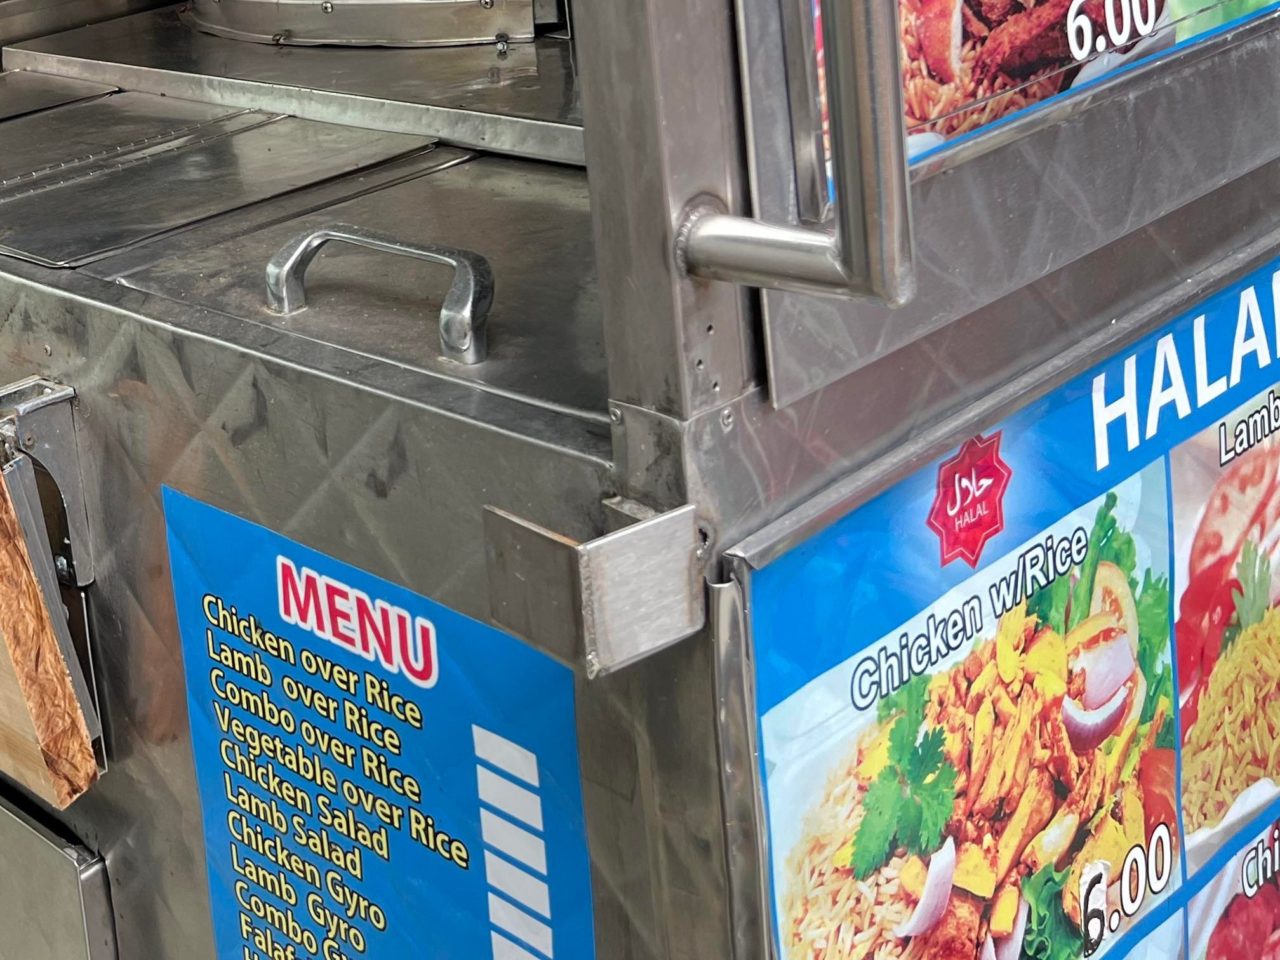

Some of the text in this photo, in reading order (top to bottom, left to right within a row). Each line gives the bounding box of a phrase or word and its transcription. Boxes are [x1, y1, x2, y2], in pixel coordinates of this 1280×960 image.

[1091, 269, 1280, 472] HALA
[1219, 389, 1280, 467] Lamb
[954, 500, 989, 532] HALAL
[202, 593, 423, 729] Chicken over Rice
[276, 554, 439, 689] MENU
[850, 526, 1089, 711] Chicken w/Rice
[206, 628, 401, 755] Lamb over Rice
[210, 668, 421, 803] Combo over Rice
[213, 700, 469, 870] Vegetable over Rice
[220, 739, 389, 861] Chicken Salad
[223, 771, 362, 880] Lamb Salad
[227, 810, 387, 931] Chicken Gyro
[230, 842, 366, 953] Lamb Gyro
[235, 879, 318, 955] Combo
[1082, 822, 1172, 958] 6.00
